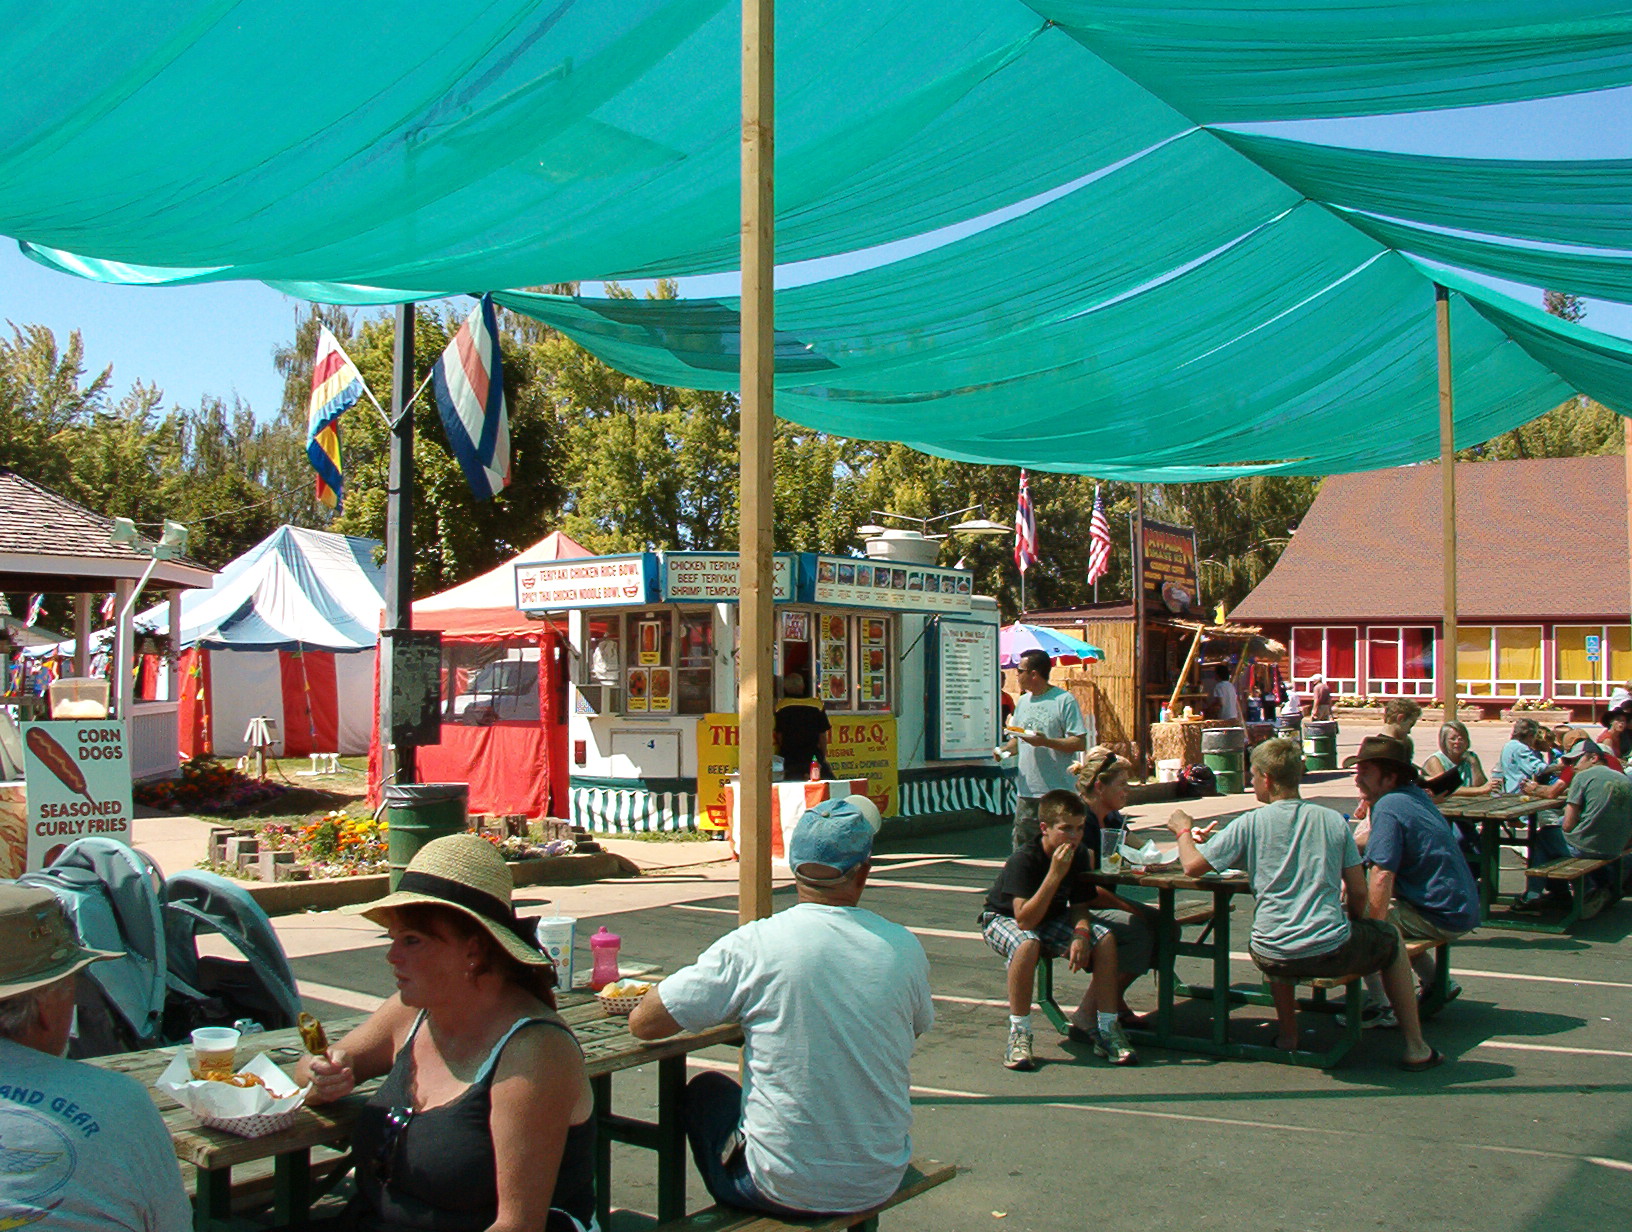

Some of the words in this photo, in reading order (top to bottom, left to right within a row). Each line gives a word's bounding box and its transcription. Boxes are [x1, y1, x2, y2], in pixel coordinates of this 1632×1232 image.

[540, 568, 569, 582] TERIYAKI
[570, 566, 599, 580] CHICKEN
[601, 565, 617, 577] RICE
[619, 563, 640, 576] BOWL
[670, 561, 706, 571] CHICKEN
[709, 561, 740, 571] TERIYAK
[677, 574, 699, 584] BEEF
[701, 574, 736, 584] TERIYAKI
[521, 591, 537, 603] SPICY
[539, 591, 551, 602] THAI
[553, 589, 577, 601] CHICKEN
[579, 588, 601, 600] NOODLE
[603, 587, 621, 598] BOWL
[671, 586, 701, 597] SHRIMP
[77, 728, 121, 743] CORN
[709, 725, 740, 746] TH
[839, 723, 889, 745] B.B.Q.
[78, 746, 123, 761] DOGS
[825, 748, 855, 758] UISINE
[707, 764, 730, 775] BEEF
[40, 800, 122, 819] SEASONED
[35, 820, 85, 837] CURLY
[88, 817, 127, 834] FRIES
[51, 1097, 100, 1138] GEAR
